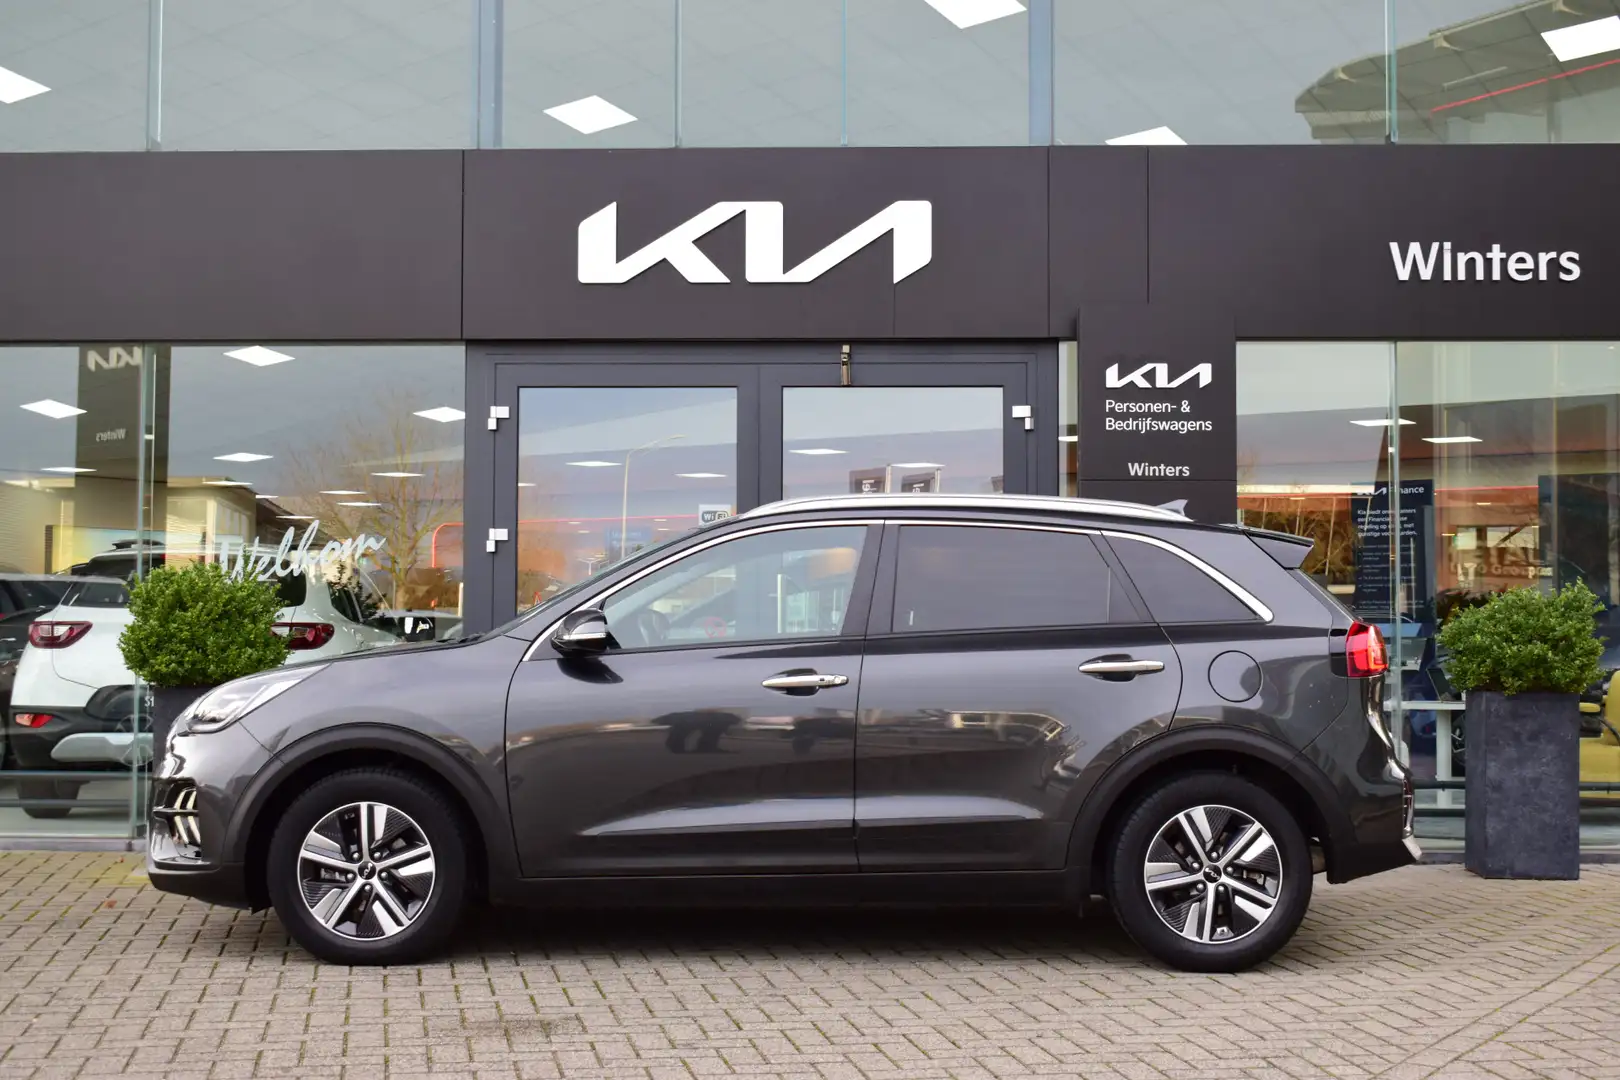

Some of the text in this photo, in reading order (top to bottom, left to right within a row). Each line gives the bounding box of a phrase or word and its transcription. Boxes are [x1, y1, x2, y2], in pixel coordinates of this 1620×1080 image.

[578, 200, 933, 284] KIA
[1389, 241, 1582, 282] Winters
[1105, 362, 1213, 389] KIA
[1105, 399, 1191, 413] Personen- &
[1105, 417, 1213, 434] Bedrijfswagens
[1127, 462, 1190, 477] Winters
